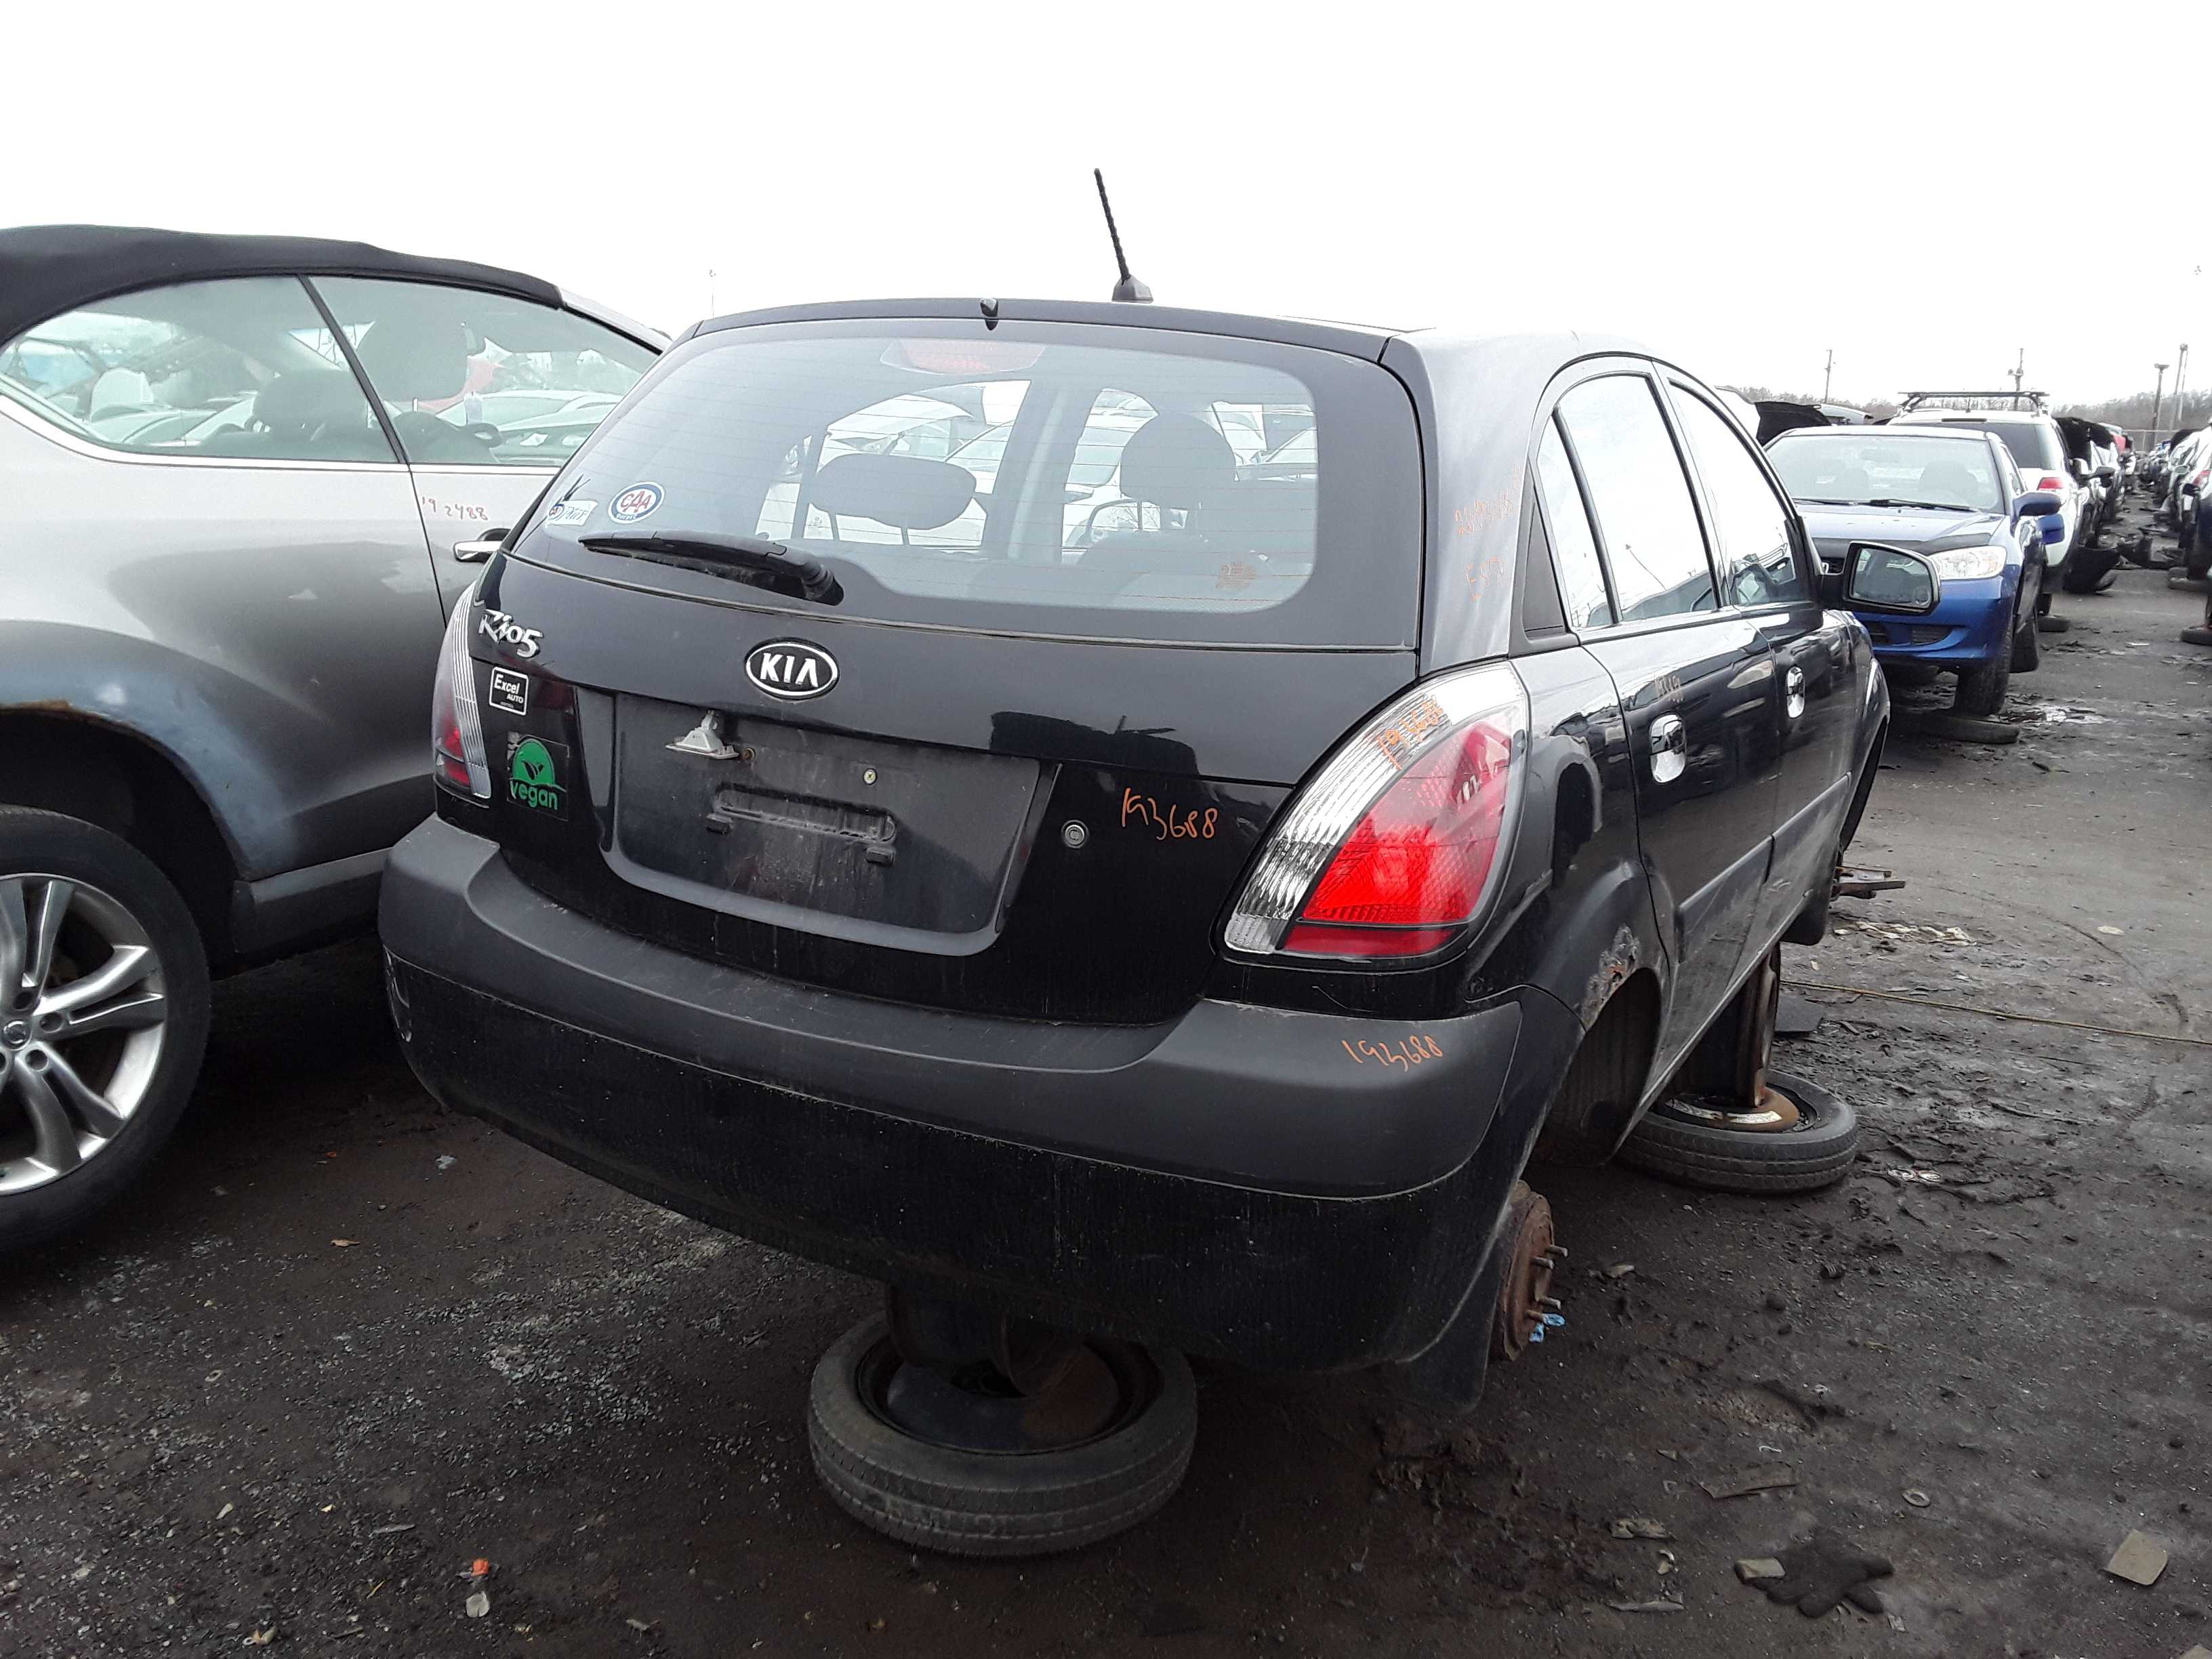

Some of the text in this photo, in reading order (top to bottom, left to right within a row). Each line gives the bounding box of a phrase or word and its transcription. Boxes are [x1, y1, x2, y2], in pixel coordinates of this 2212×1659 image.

[619, 490, 652, 513] CAA
[478, 609, 544, 658] Rio5
[760, 653, 819, 687] KIA
[494, 673, 520, 695] Excel
[507, 693, 524, 704] AUTO
[509, 780, 558, 810] vegan
